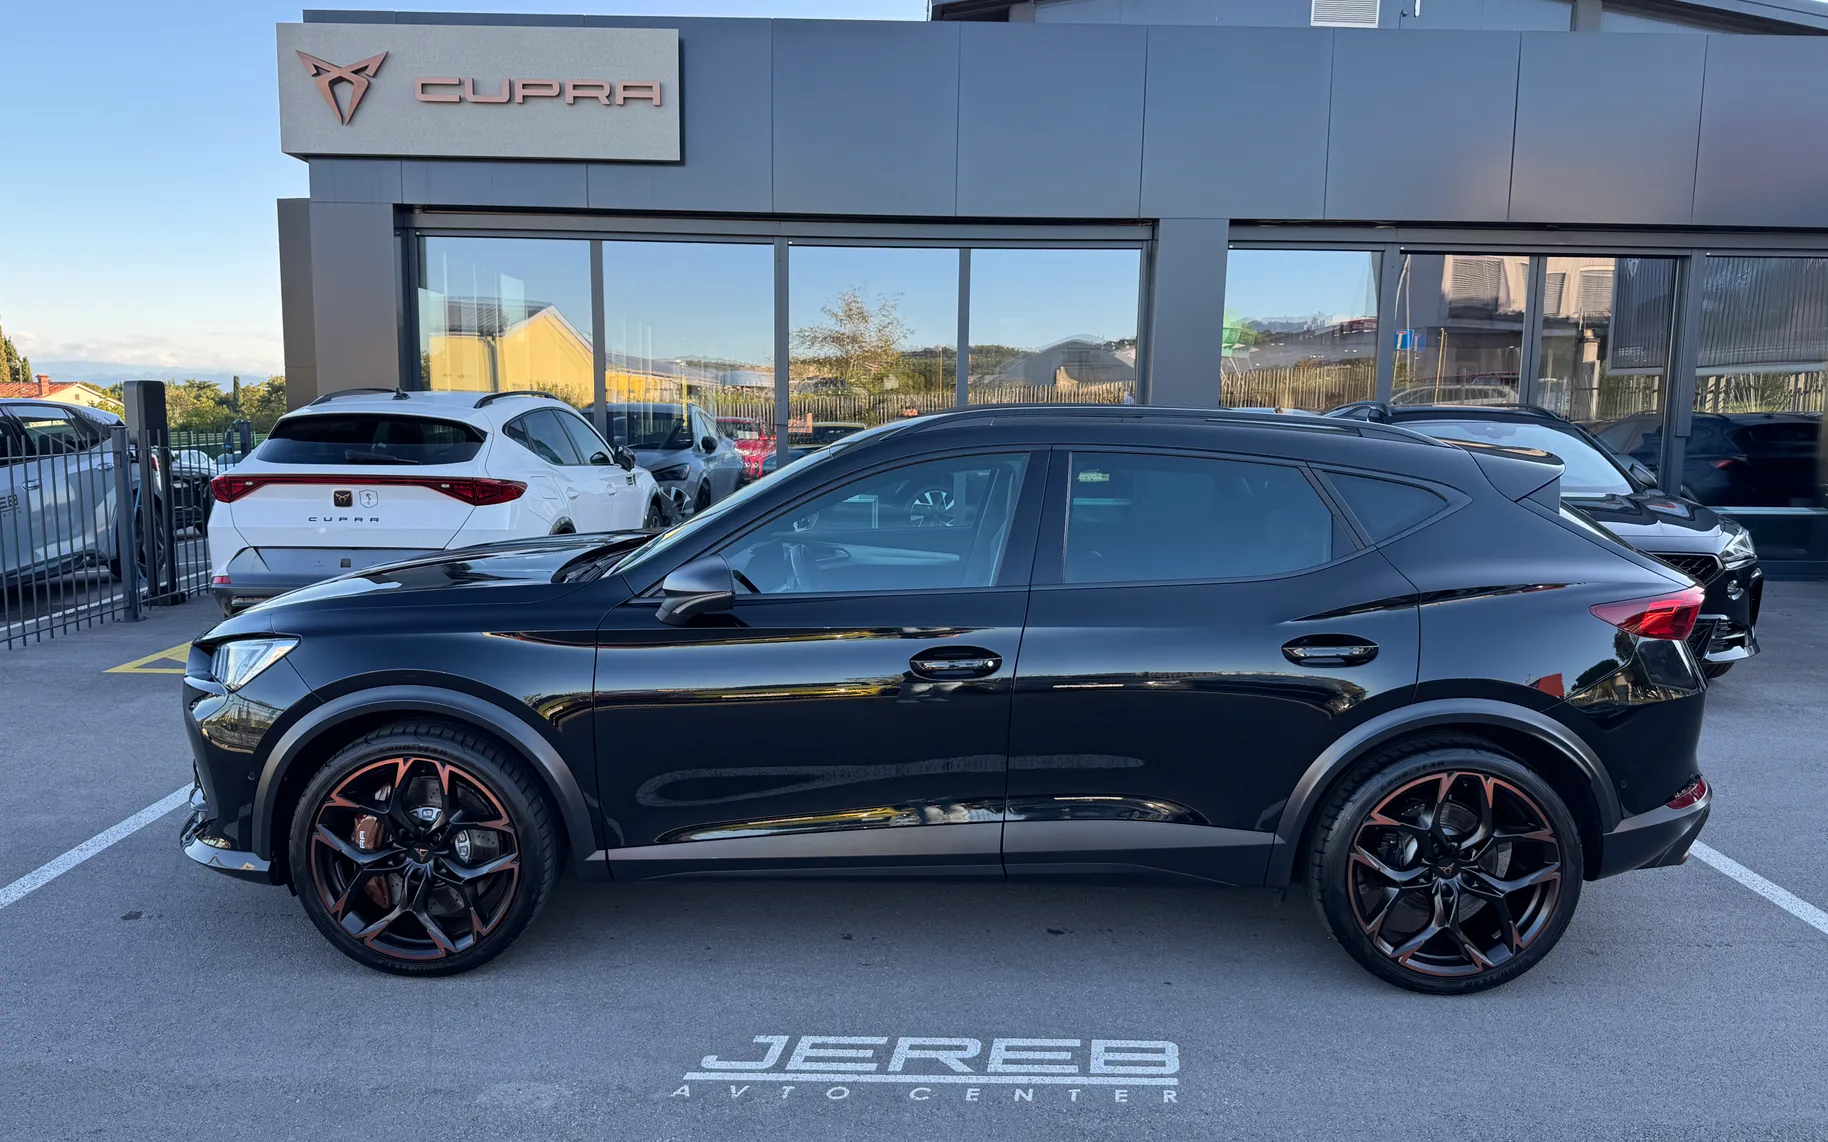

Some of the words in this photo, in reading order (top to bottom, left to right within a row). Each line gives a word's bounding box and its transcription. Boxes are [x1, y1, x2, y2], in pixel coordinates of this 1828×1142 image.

[415, 78, 661, 106] CUPRA
[701, 1035, 1180, 1075] JEREB
[670, 1084, 850, 1100] AVTO
[909, 1087, 1179, 1104] CENTER
